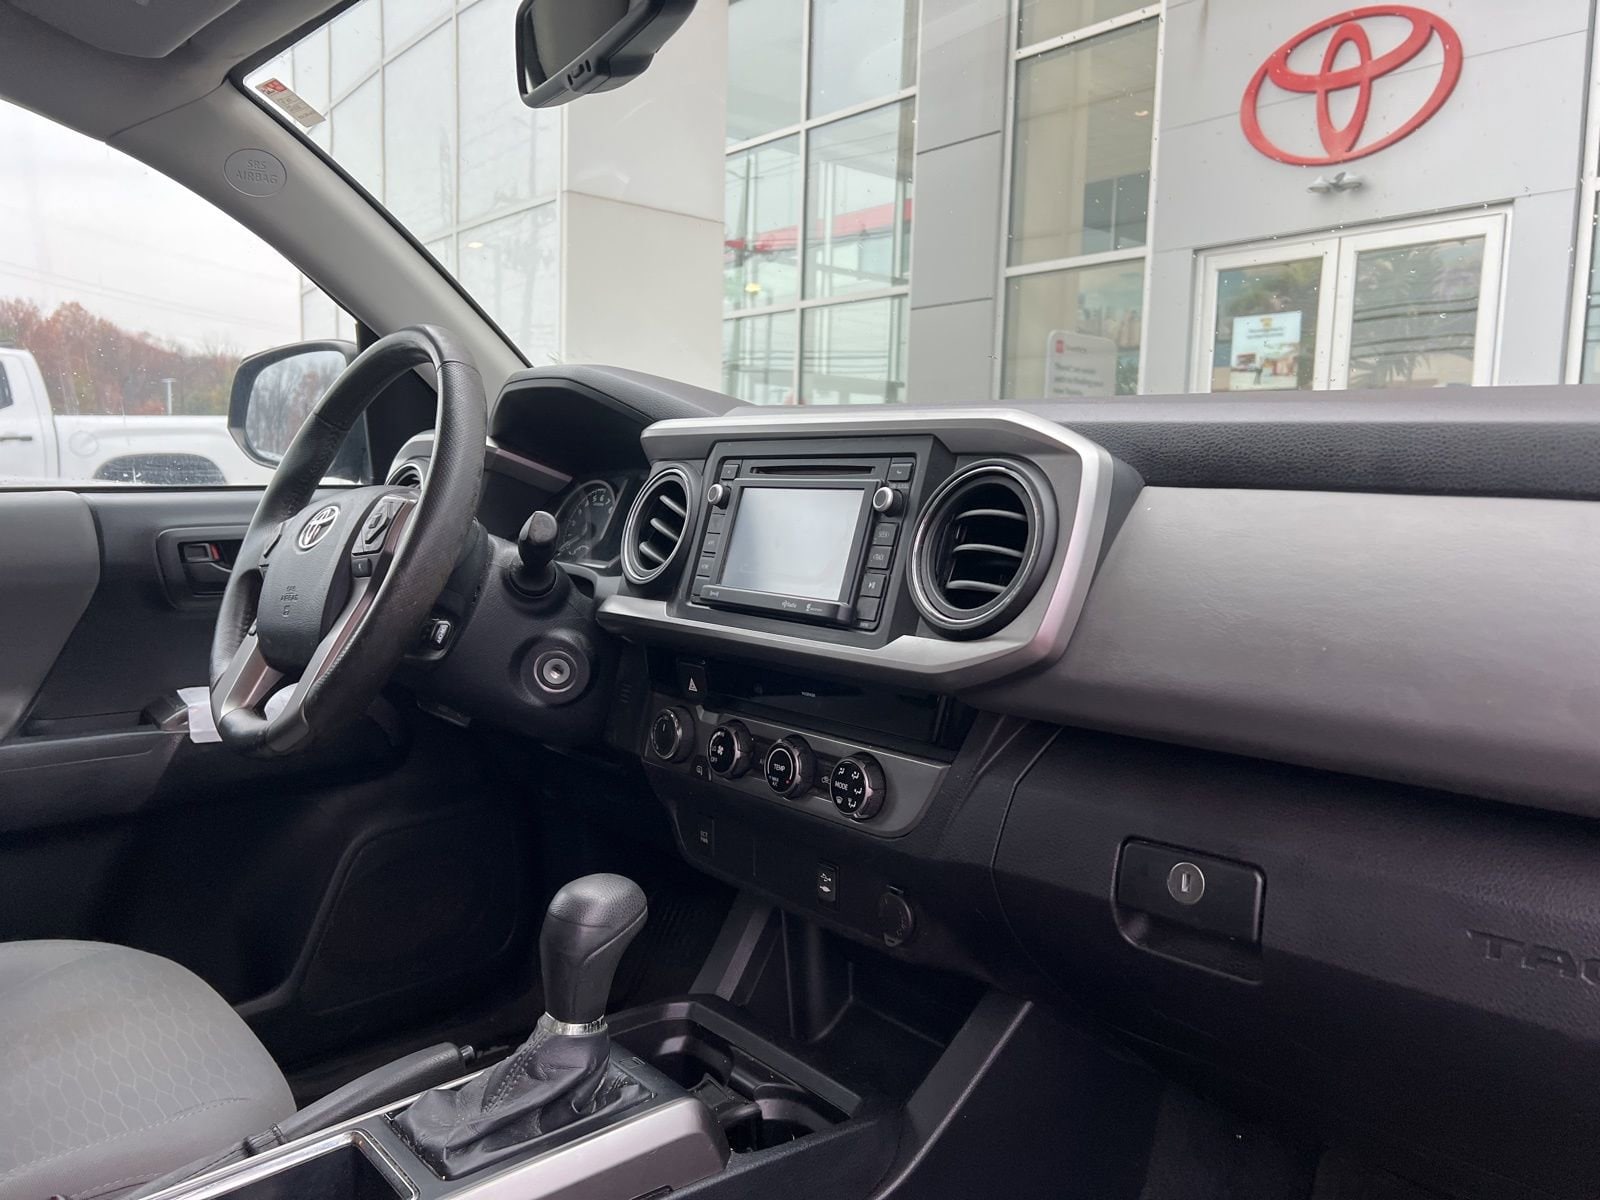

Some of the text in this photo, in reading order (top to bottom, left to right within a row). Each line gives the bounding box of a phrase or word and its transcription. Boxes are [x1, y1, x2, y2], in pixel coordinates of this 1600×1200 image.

[247, 159, 266, 170] SRS
[235, 168, 278, 184] AIRBAG
[773, 763, 786, 772] TEMP
[834, 780, 848, 791] MODE
